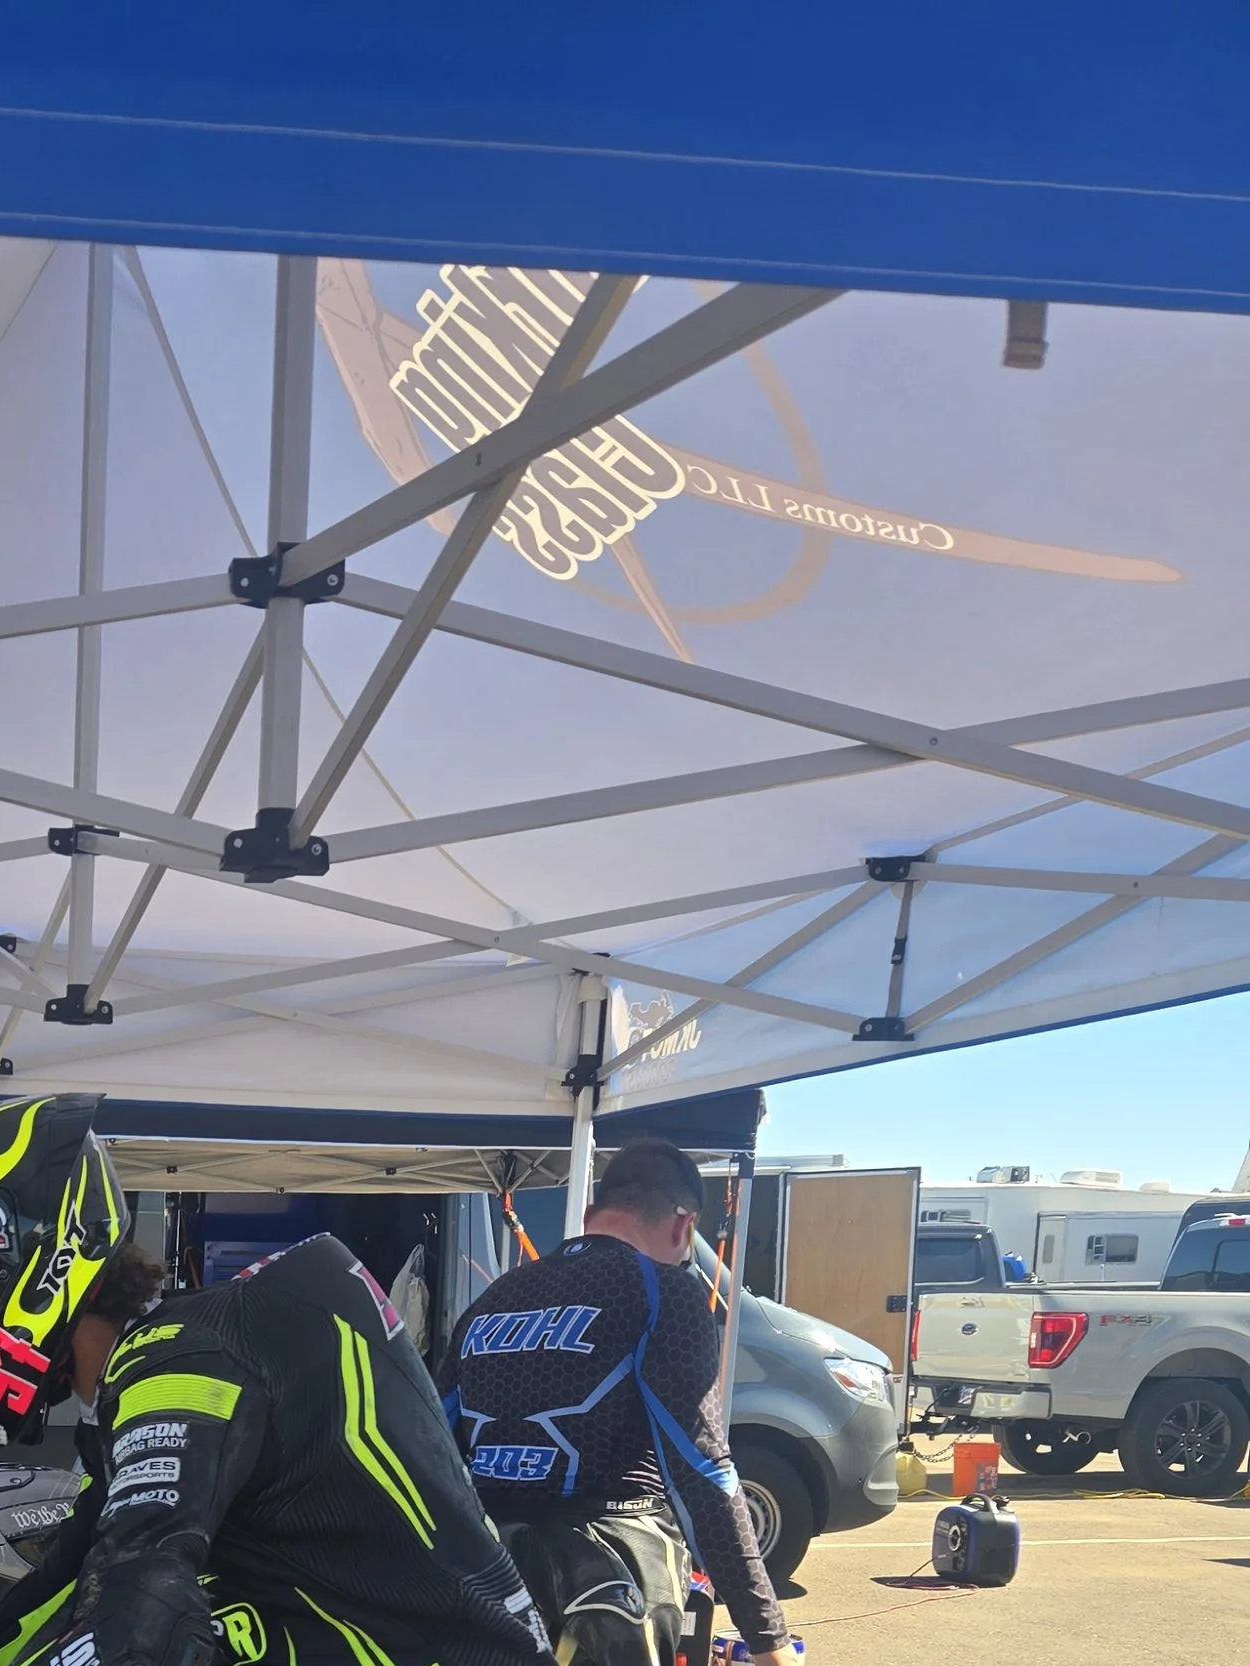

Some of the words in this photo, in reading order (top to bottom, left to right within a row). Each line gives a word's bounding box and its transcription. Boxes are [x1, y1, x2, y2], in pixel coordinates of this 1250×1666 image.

[461, 1305, 602, 1360] KOHL
[115, 1440, 146, 1466] AIRBAG
[147, 1437, 187, 1448] READY
[470, 1445, 559, 1481] 203
[11, 1508, 40, 1528] We
[606, 1498, 655, 1512] BISON
